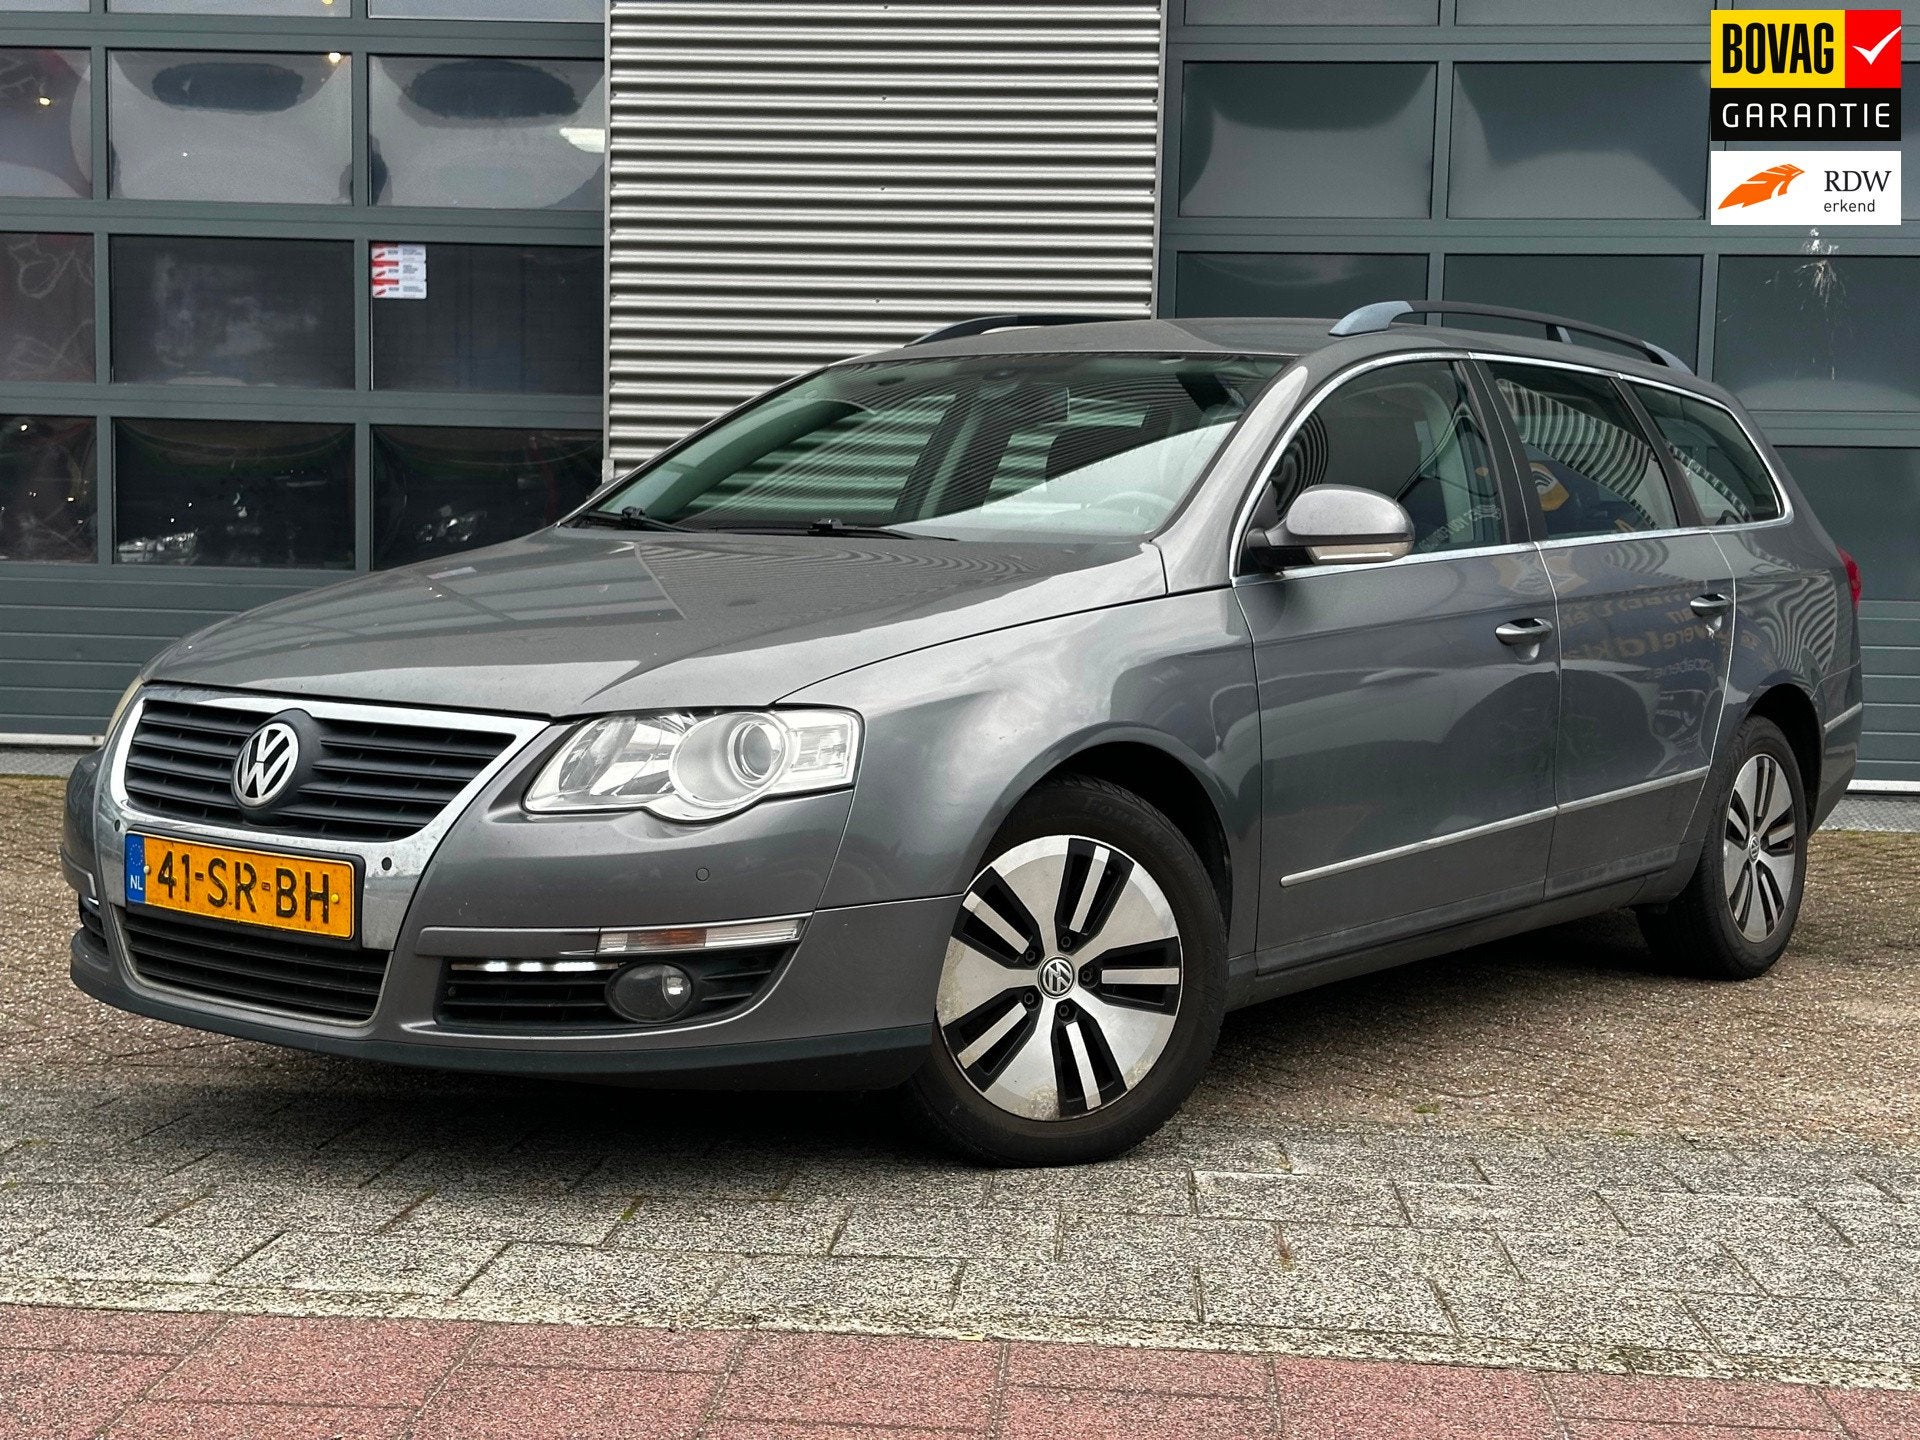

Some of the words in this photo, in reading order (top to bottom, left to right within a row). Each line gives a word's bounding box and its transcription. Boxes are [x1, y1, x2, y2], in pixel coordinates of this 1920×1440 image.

[236, 724, 298, 807] VW
[130, 874, 143, 891] NL
[158, 851, 329, 924] 41-SR-BH
